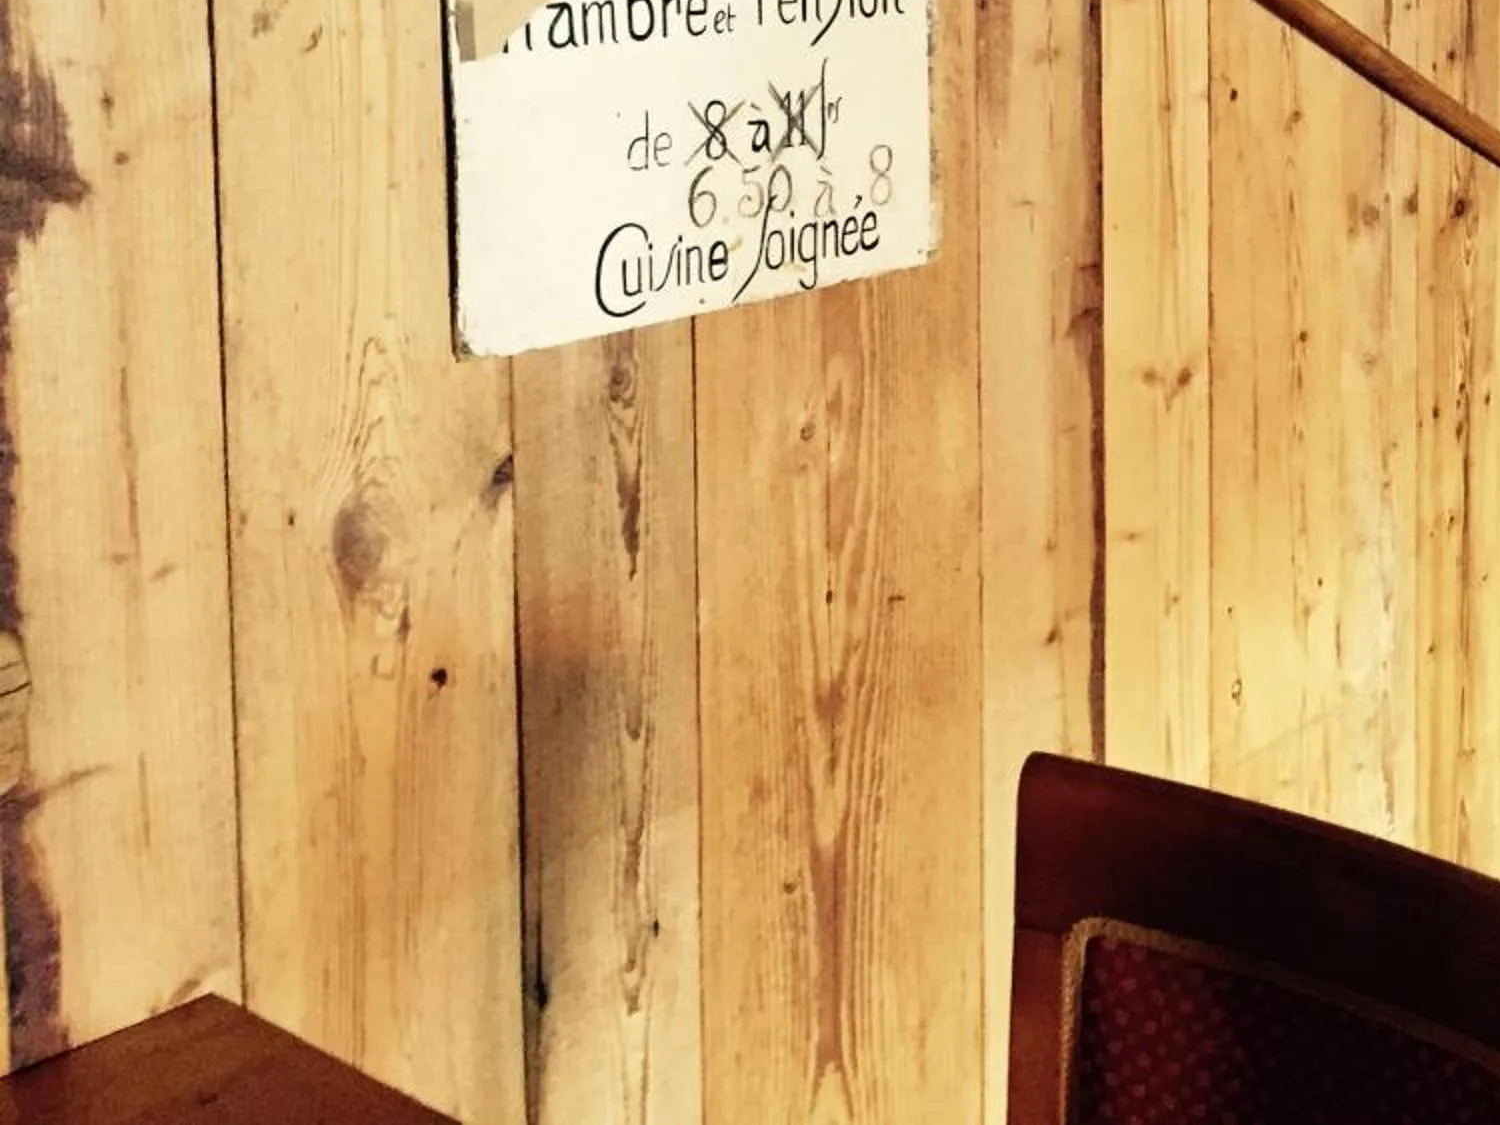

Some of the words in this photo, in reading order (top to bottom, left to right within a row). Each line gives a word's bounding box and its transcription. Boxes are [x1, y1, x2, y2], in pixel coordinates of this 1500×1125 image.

[713, 3, 736, 34] et
[627, 110, 673, 171] de
[869, 144, 893, 206] 8
[595, 222, 729, 318] Cuisine
